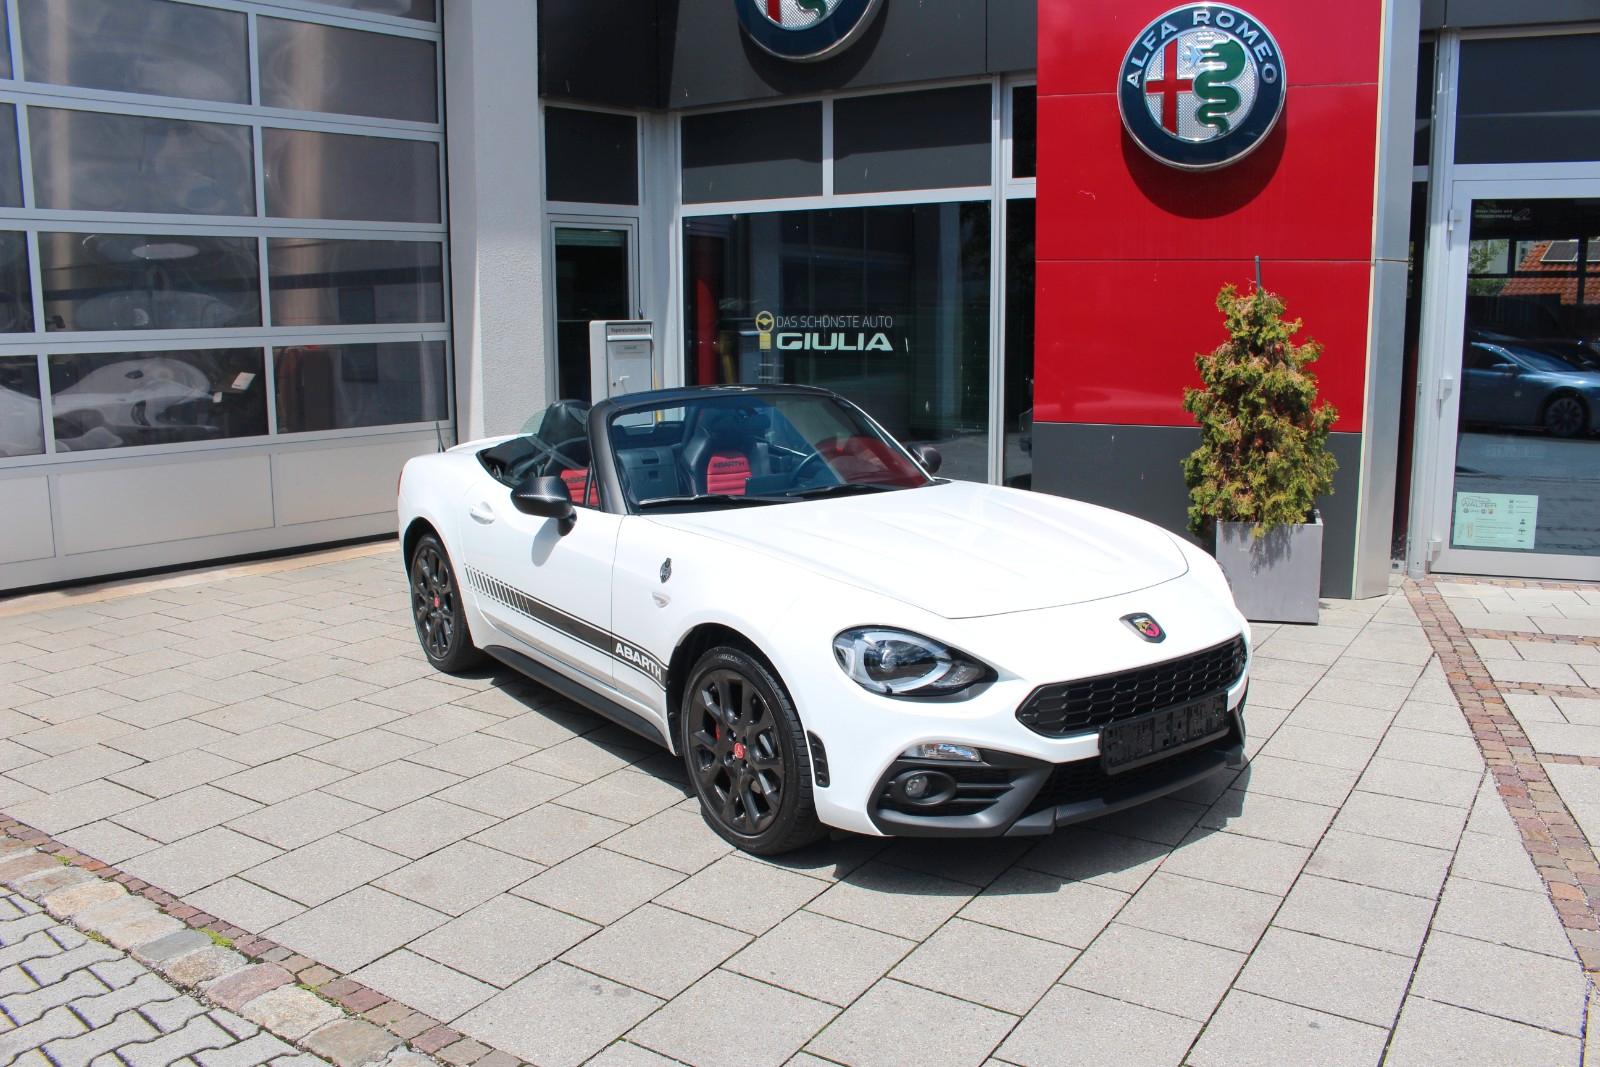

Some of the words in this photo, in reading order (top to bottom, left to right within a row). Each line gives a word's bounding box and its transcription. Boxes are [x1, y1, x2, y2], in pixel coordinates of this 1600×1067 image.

[1126, 20, 1178, 88] ALFA
[1192, 10, 1278, 84] ROMEO
[776, 315, 798, 328] DAS
[862, 315, 893, 328] AUTO
[776, 333, 893, 351] GIULIA
[615, 642, 662, 681] ABARTH
